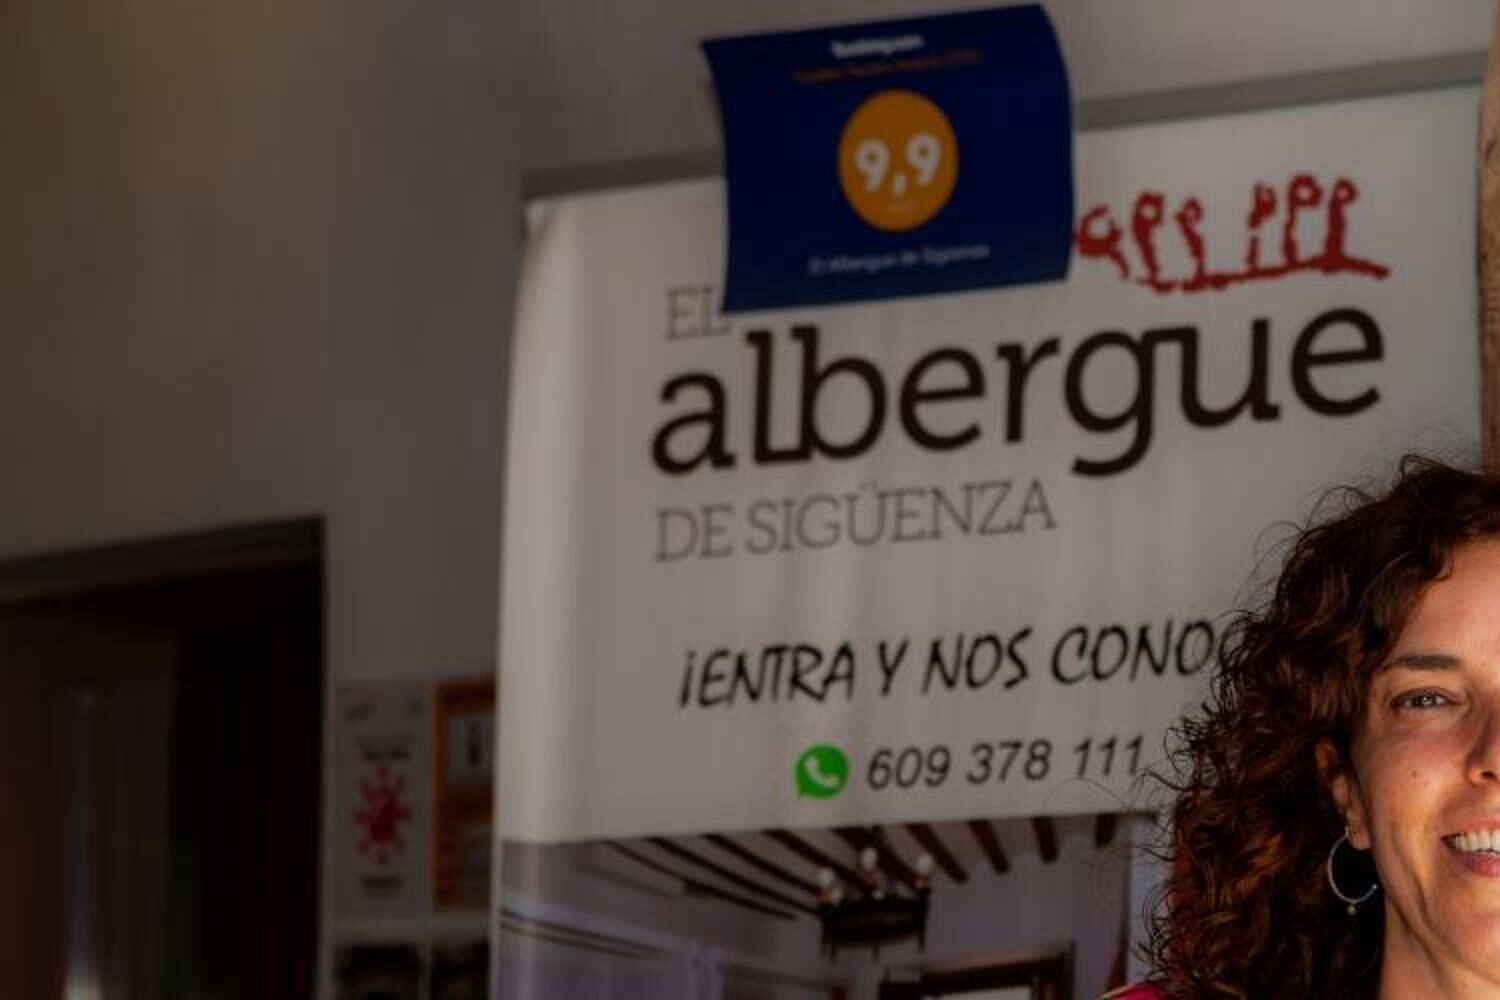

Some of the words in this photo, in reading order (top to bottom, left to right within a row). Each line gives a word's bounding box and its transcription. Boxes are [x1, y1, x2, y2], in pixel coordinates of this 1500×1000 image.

[856, 133, 941, 197] 9,9
[666, 286, 731, 341] EL
[652, 308, 1384, 478] albergue
[656, 503, 735, 563] DE
[745, 475, 1058, 556] SIGÜENZA
[877, 637, 909, 696] Y
[922, 626, 1033, 696] NOS
[867, 744, 951, 790] 609
[966, 739, 1052, 785] 378
[1073, 736, 1143, 778] 111
